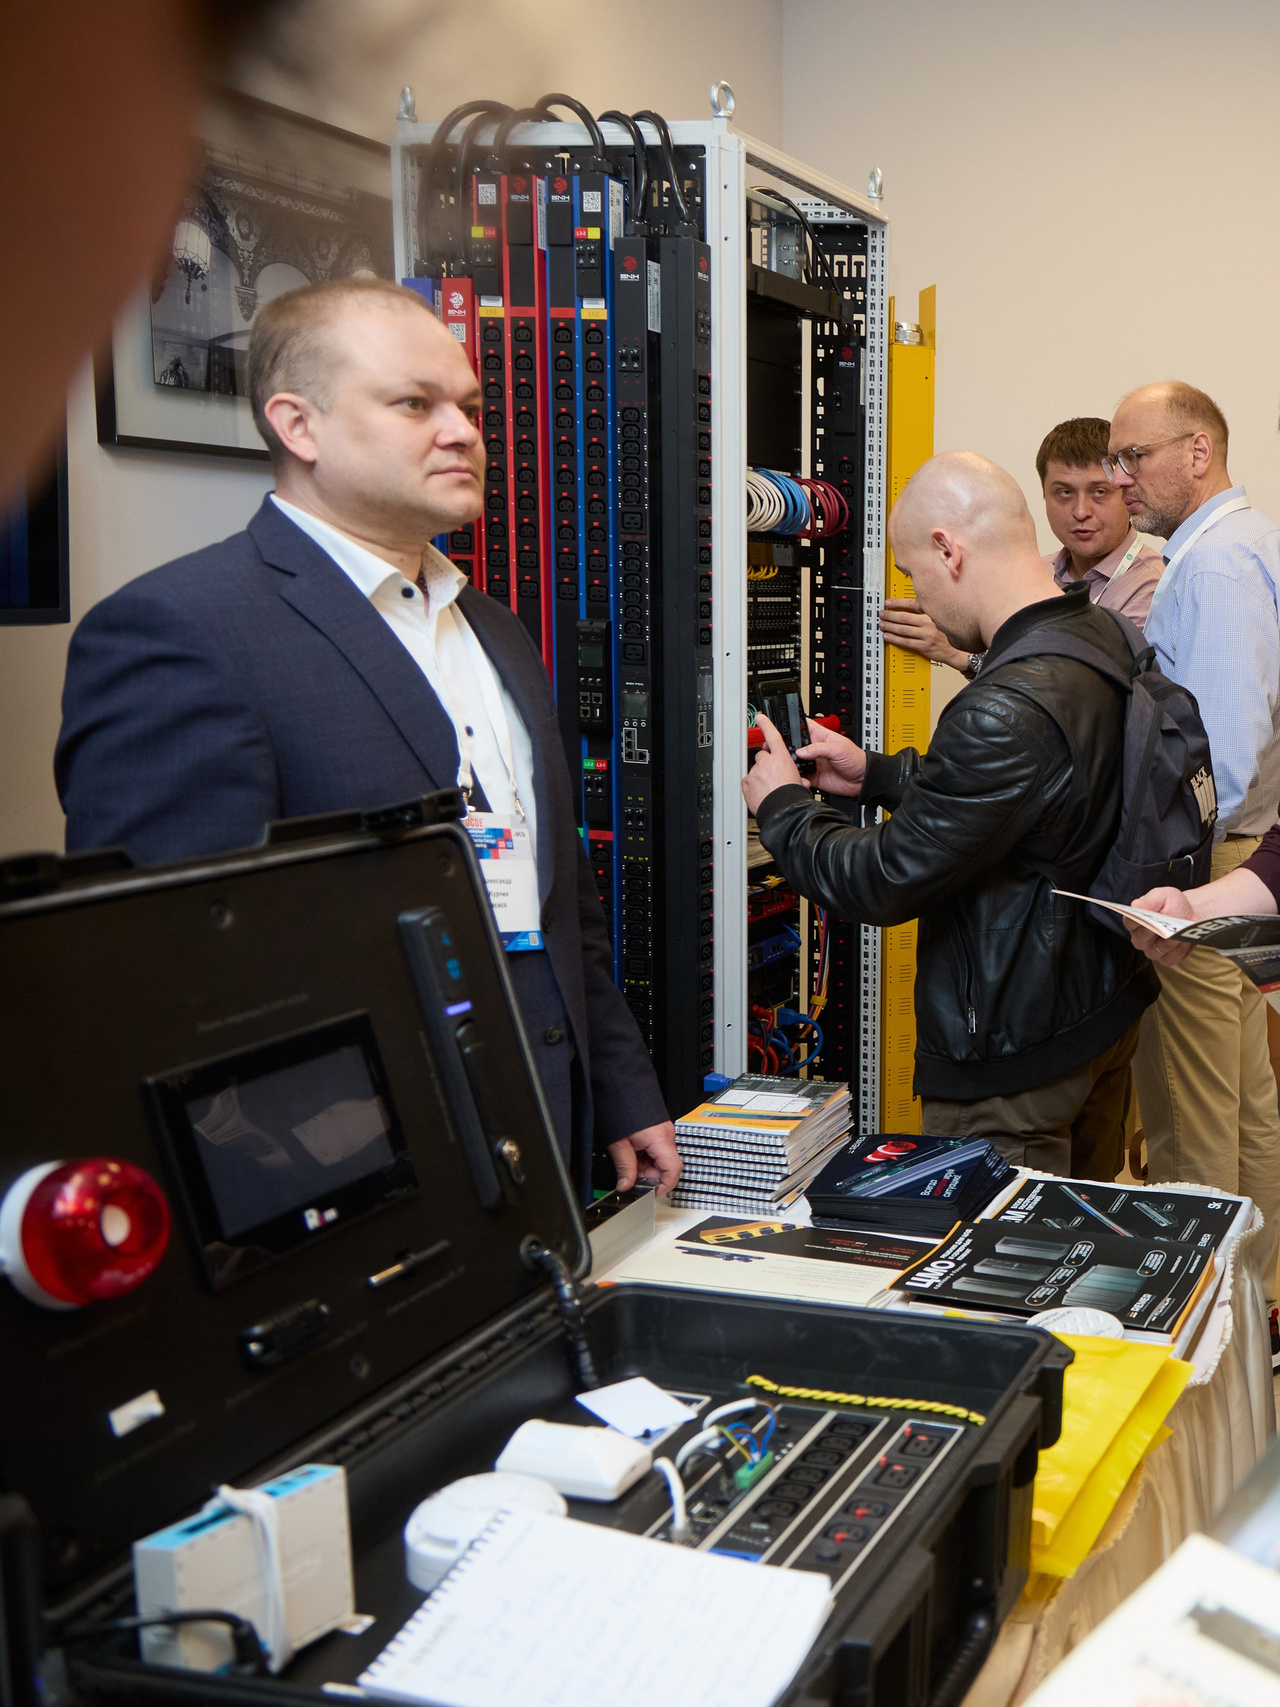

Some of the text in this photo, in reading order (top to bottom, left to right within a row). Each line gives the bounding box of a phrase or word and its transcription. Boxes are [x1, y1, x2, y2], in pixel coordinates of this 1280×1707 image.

[1190, 766, 1208, 790] BLACK
[920, 1179, 938, 1197] Всегда
[905, 1260, 956, 1290] ЦМО
